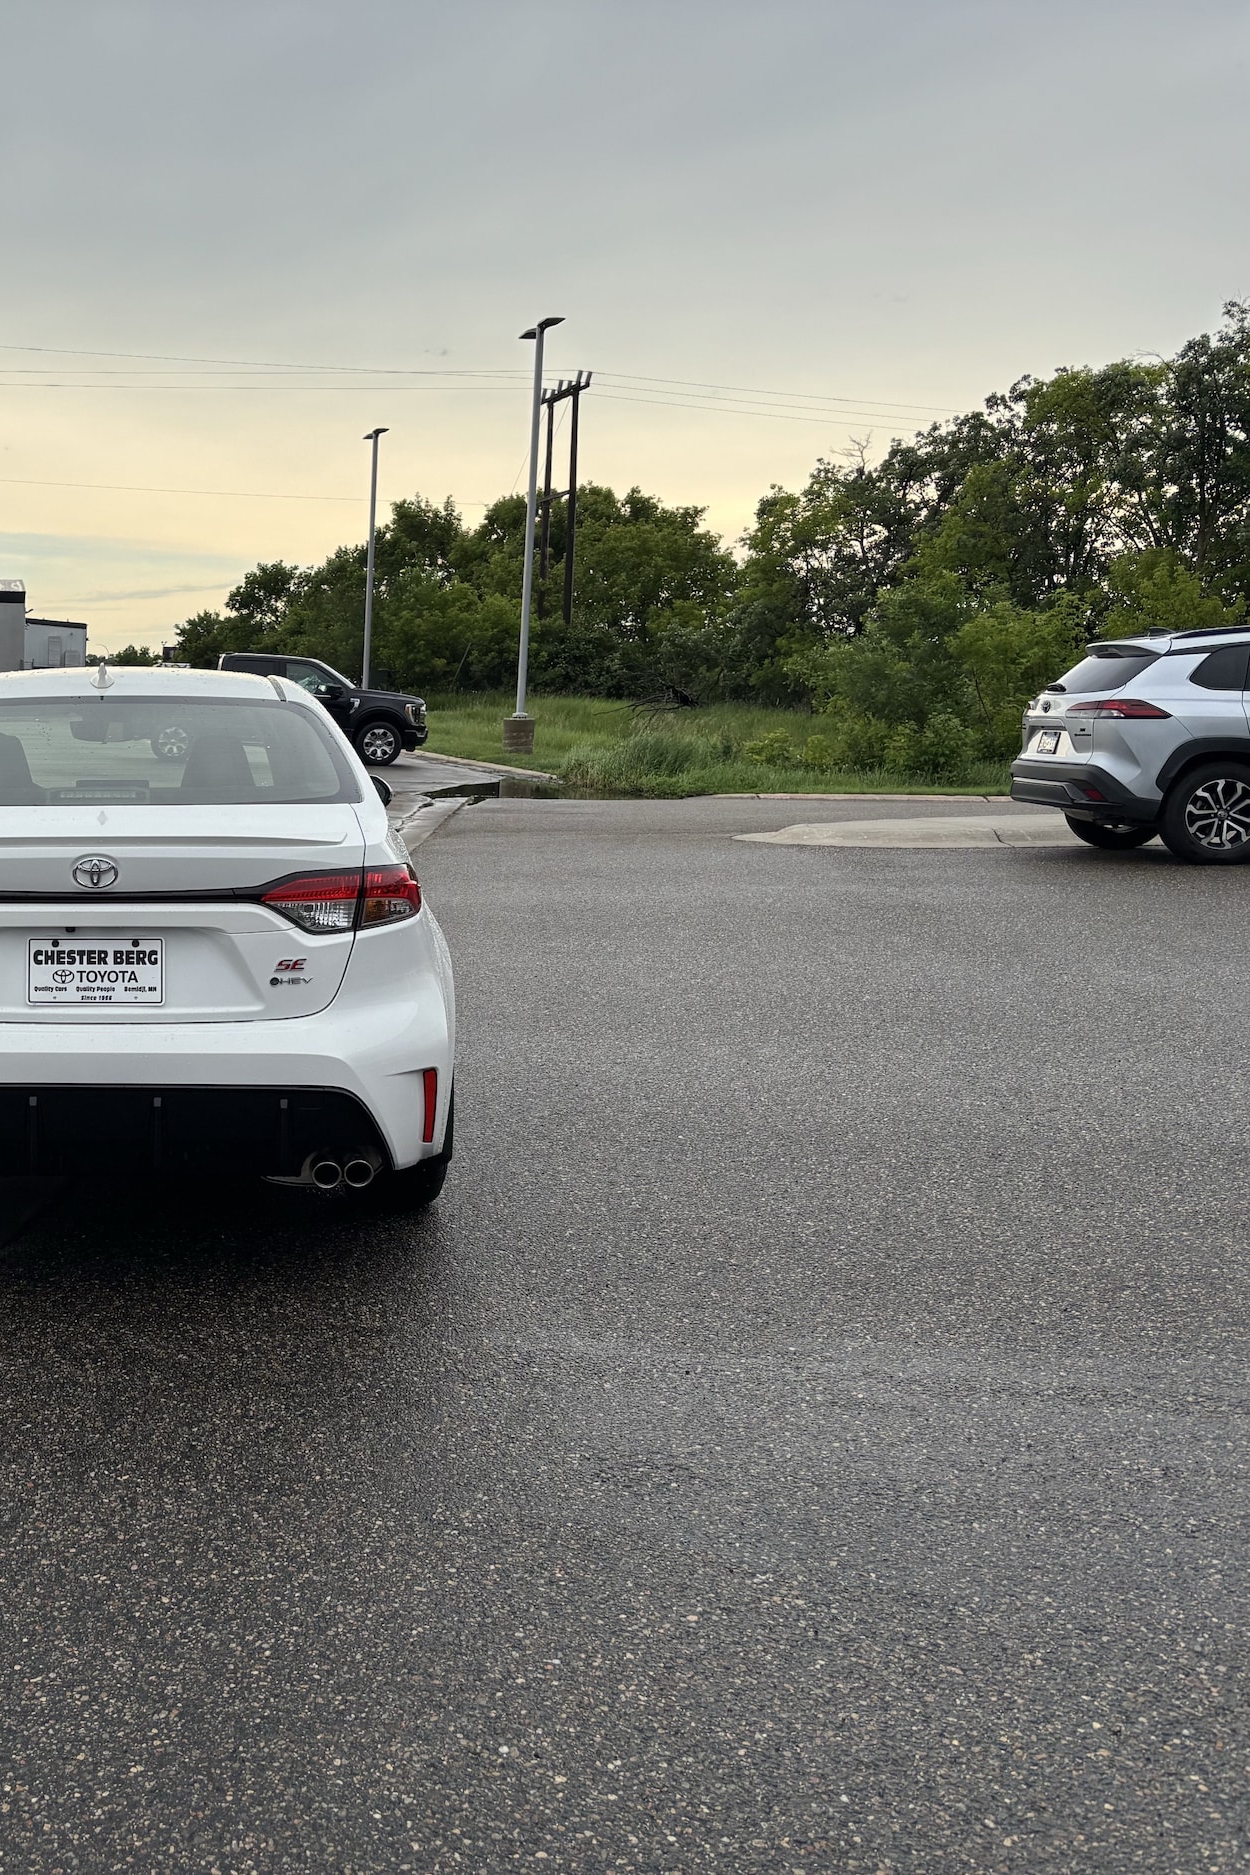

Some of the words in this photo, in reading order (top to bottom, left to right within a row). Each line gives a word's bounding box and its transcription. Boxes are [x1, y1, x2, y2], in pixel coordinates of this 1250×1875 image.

[33, 949, 109, 966] CHESTER
[113, 949, 159, 966] BERG
[274, 958, 307, 972] SE
[76, 970, 139, 983] TOYOTA
[280, 977, 313, 985] HEV
